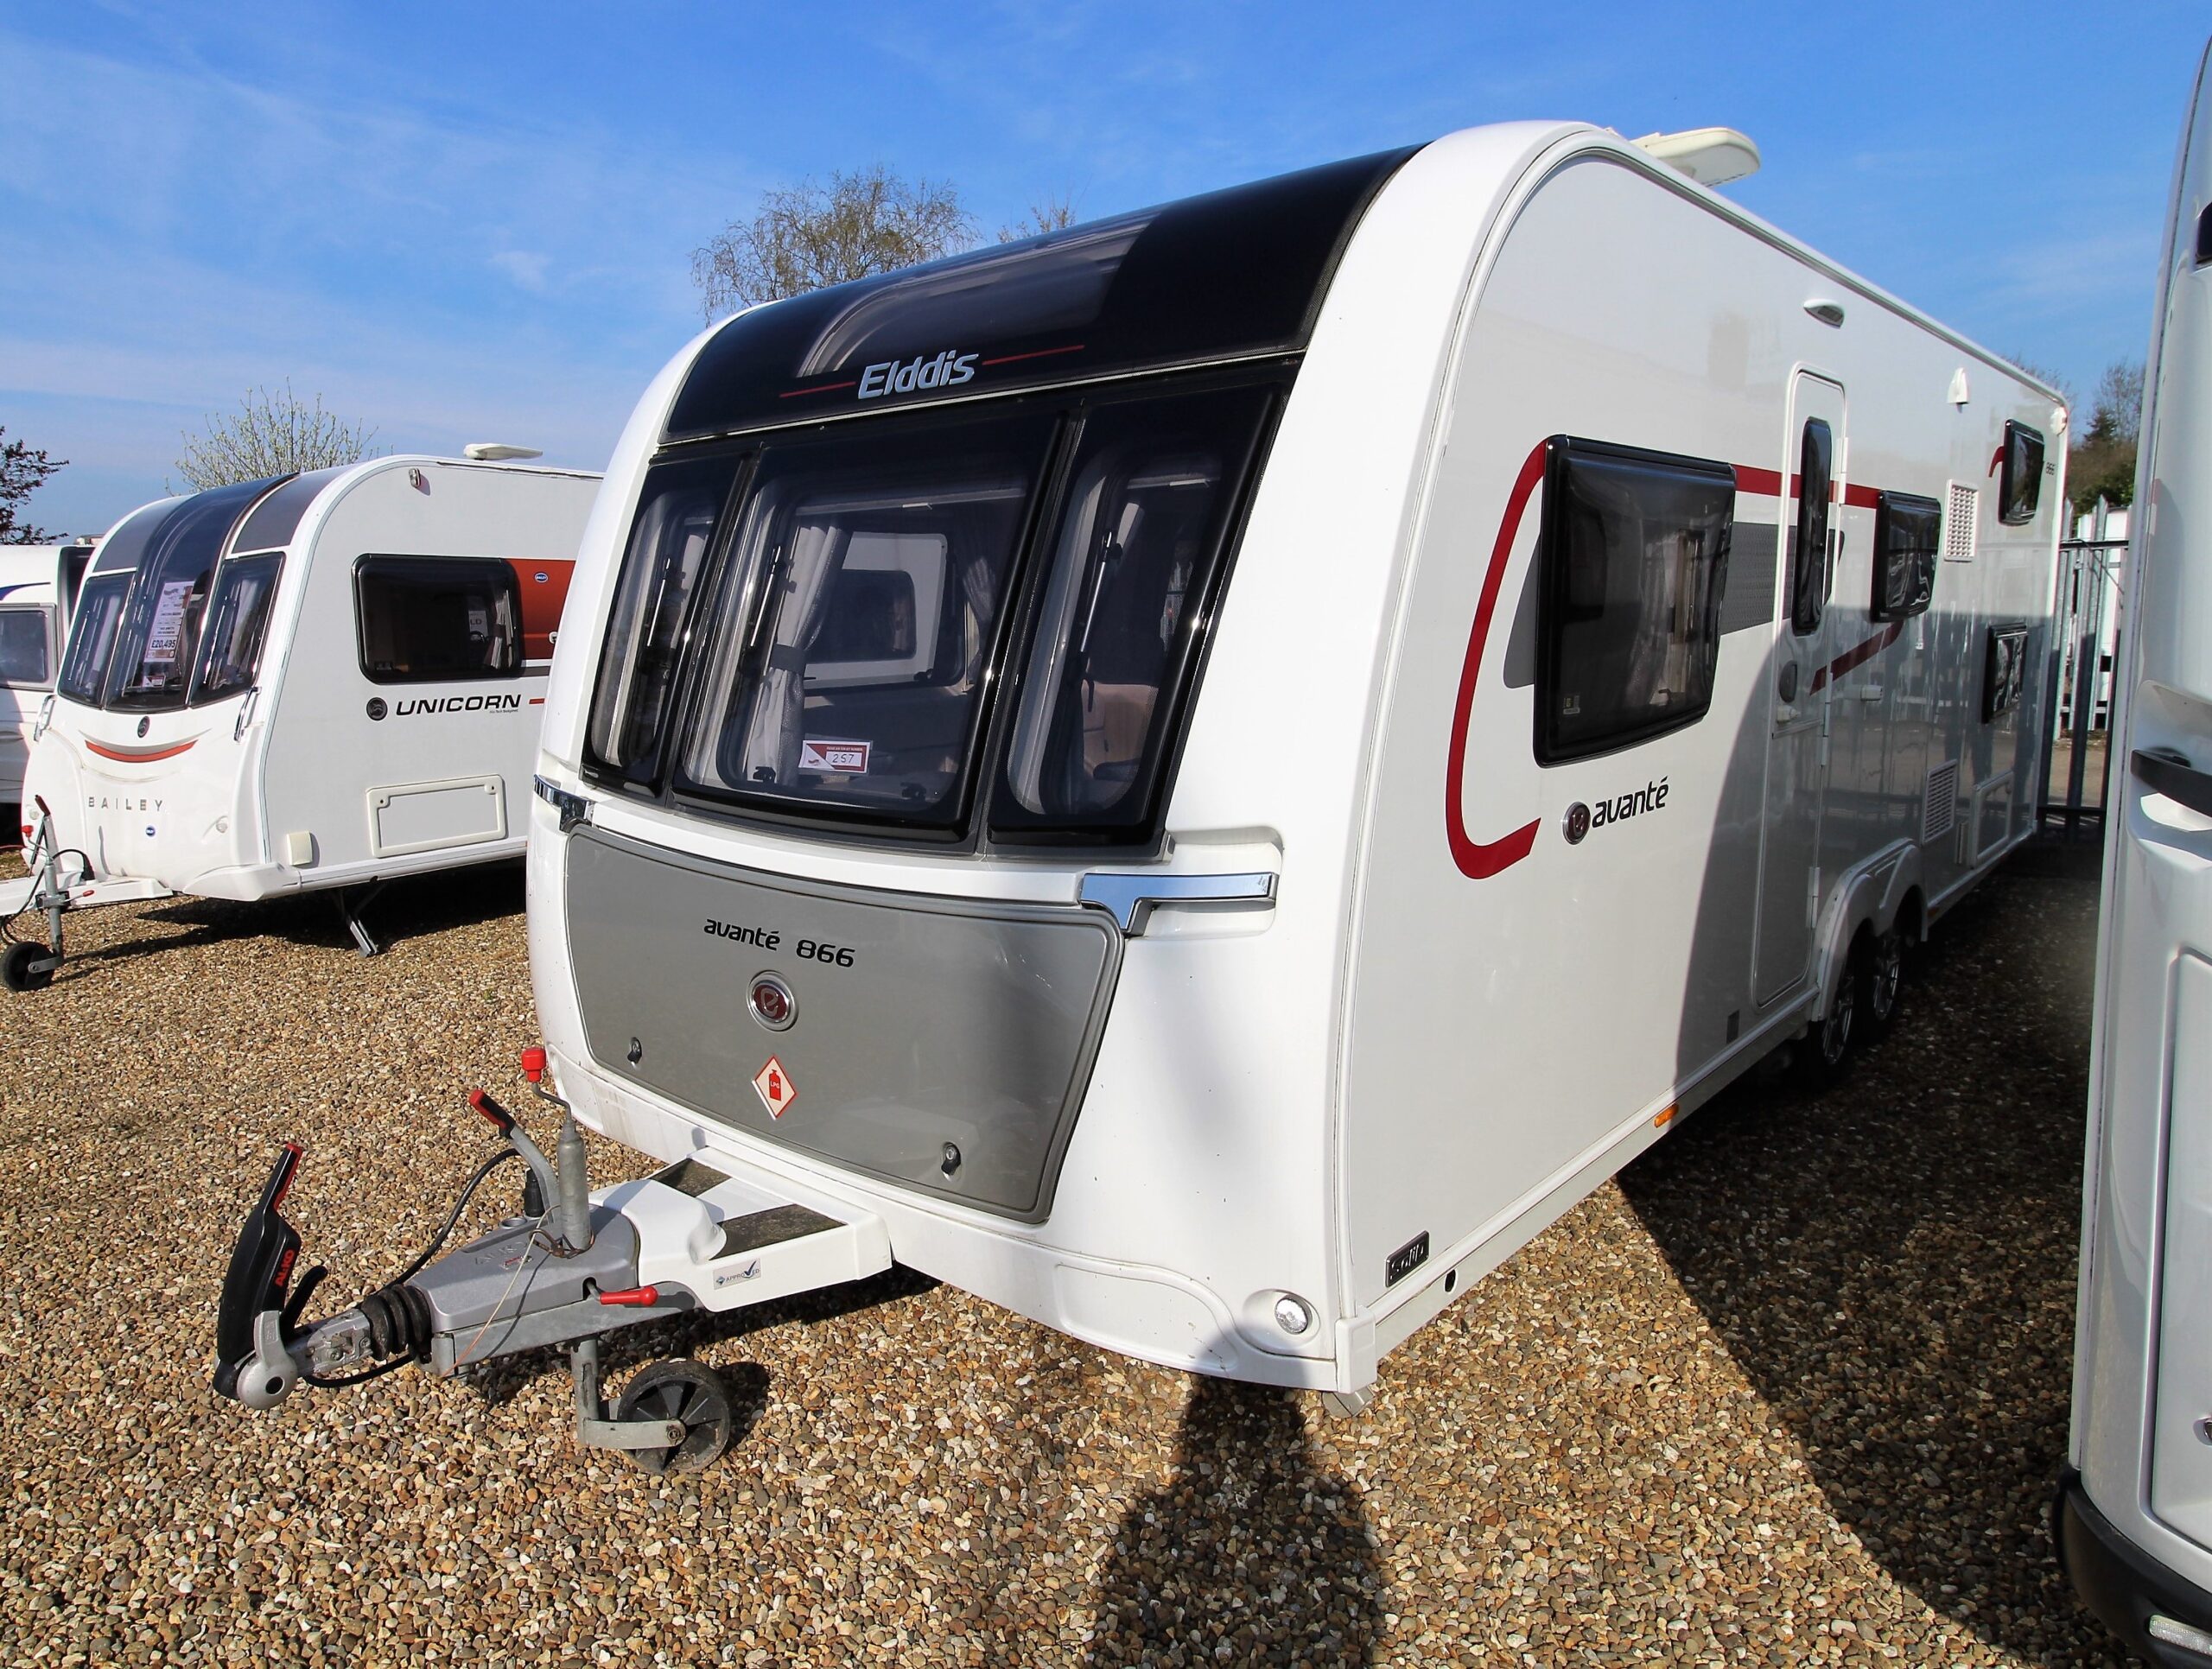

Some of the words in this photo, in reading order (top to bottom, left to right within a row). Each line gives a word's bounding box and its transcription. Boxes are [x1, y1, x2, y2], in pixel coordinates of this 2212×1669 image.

[857, 349, 979, 400] Elddis
[151, 639, 176, 649] £20,495
[396, 695, 521, 716] UNICORN
[832, 753, 855, 764] 257
[88, 796, 162, 811] BAILEY
[1592, 776, 1669, 828] avanté
[703, 918, 780, 951] avanté
[796, 939, 855, 968] 866
[770, 1081, 780, 1089] LPG
